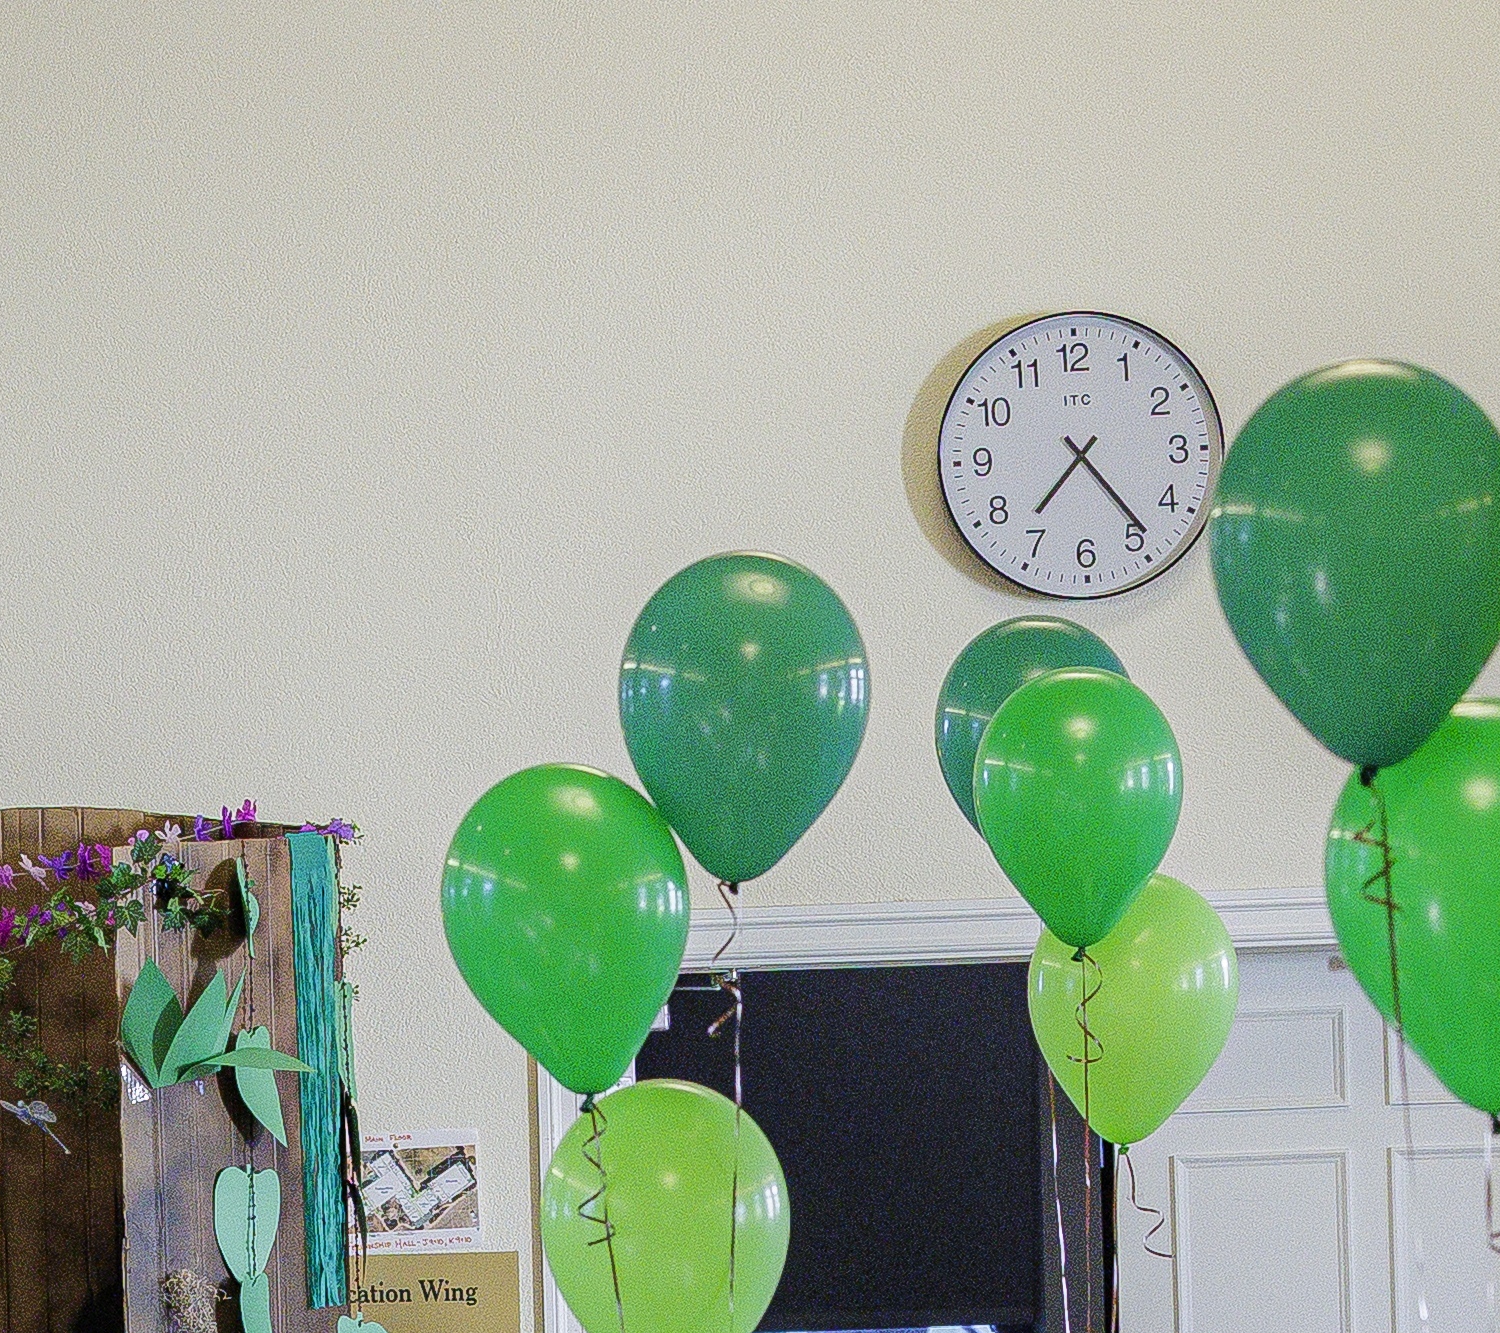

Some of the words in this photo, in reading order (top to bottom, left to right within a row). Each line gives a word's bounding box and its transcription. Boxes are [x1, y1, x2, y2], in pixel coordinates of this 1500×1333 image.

[1056, 342, 1090, 373] 12
[1117, 352, 1130, 381] 1
[1011, 359, 1040, 389] 11
[978, 397, 1011, 427] 10
[1064, 393, 1092, 407] ITC
[1150, 386, 1171, 416] 2
[973, 447, 993, 477] 9
[1168, 434, 1189, 464] 3
[989, 495, 1009, 525] 8
[1158, 484, 1180, 513] 4
[1025, 529, 1046, 559] 7
[1124, 522, 1146, 552] 5
[1075, 538, 1097, 568] 6
[349, 1281, 412, 1304] cation
[418, 1278, 478, 1306] Wing
